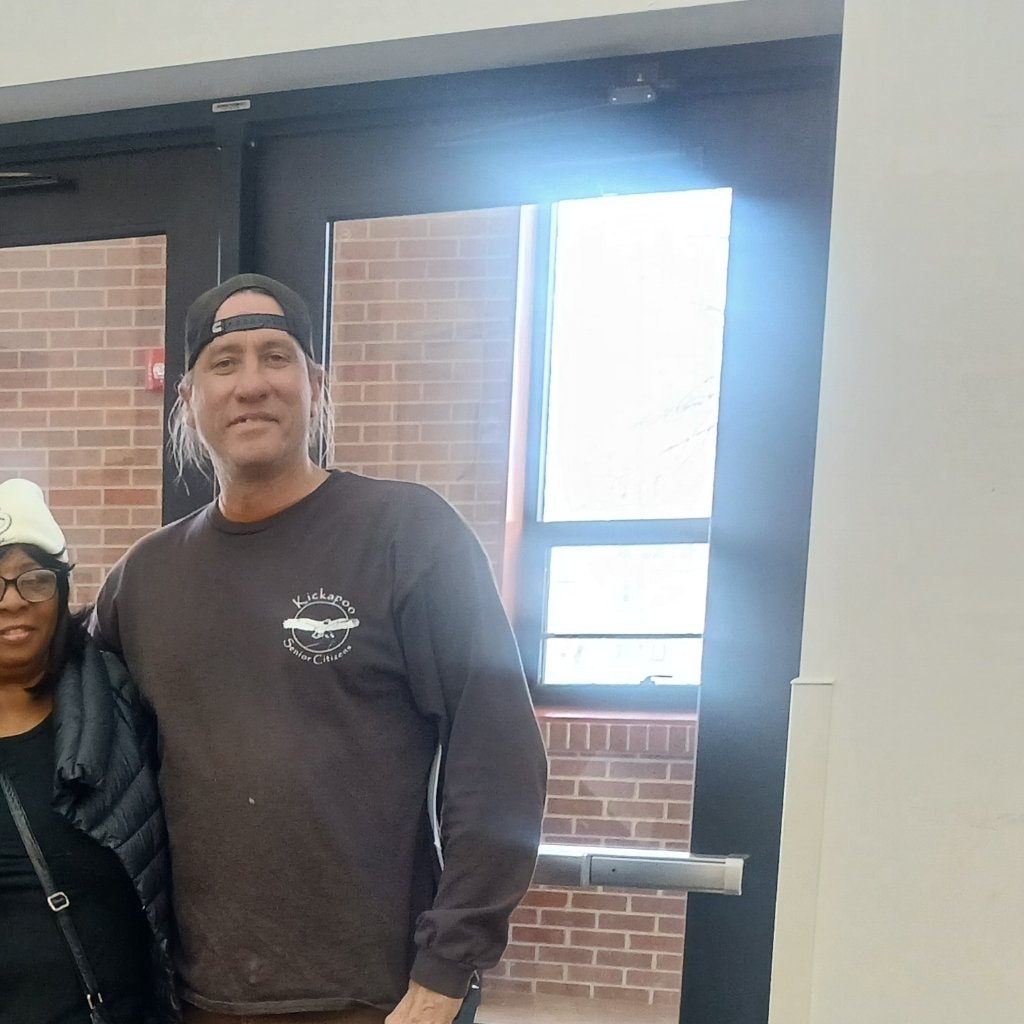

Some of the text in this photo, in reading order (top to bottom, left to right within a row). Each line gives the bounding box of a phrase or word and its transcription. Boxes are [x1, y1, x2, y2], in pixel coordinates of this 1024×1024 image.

[292, 588, 356, 615] Kickapoo
[283, 638, 352, 665] Senior Citizens
